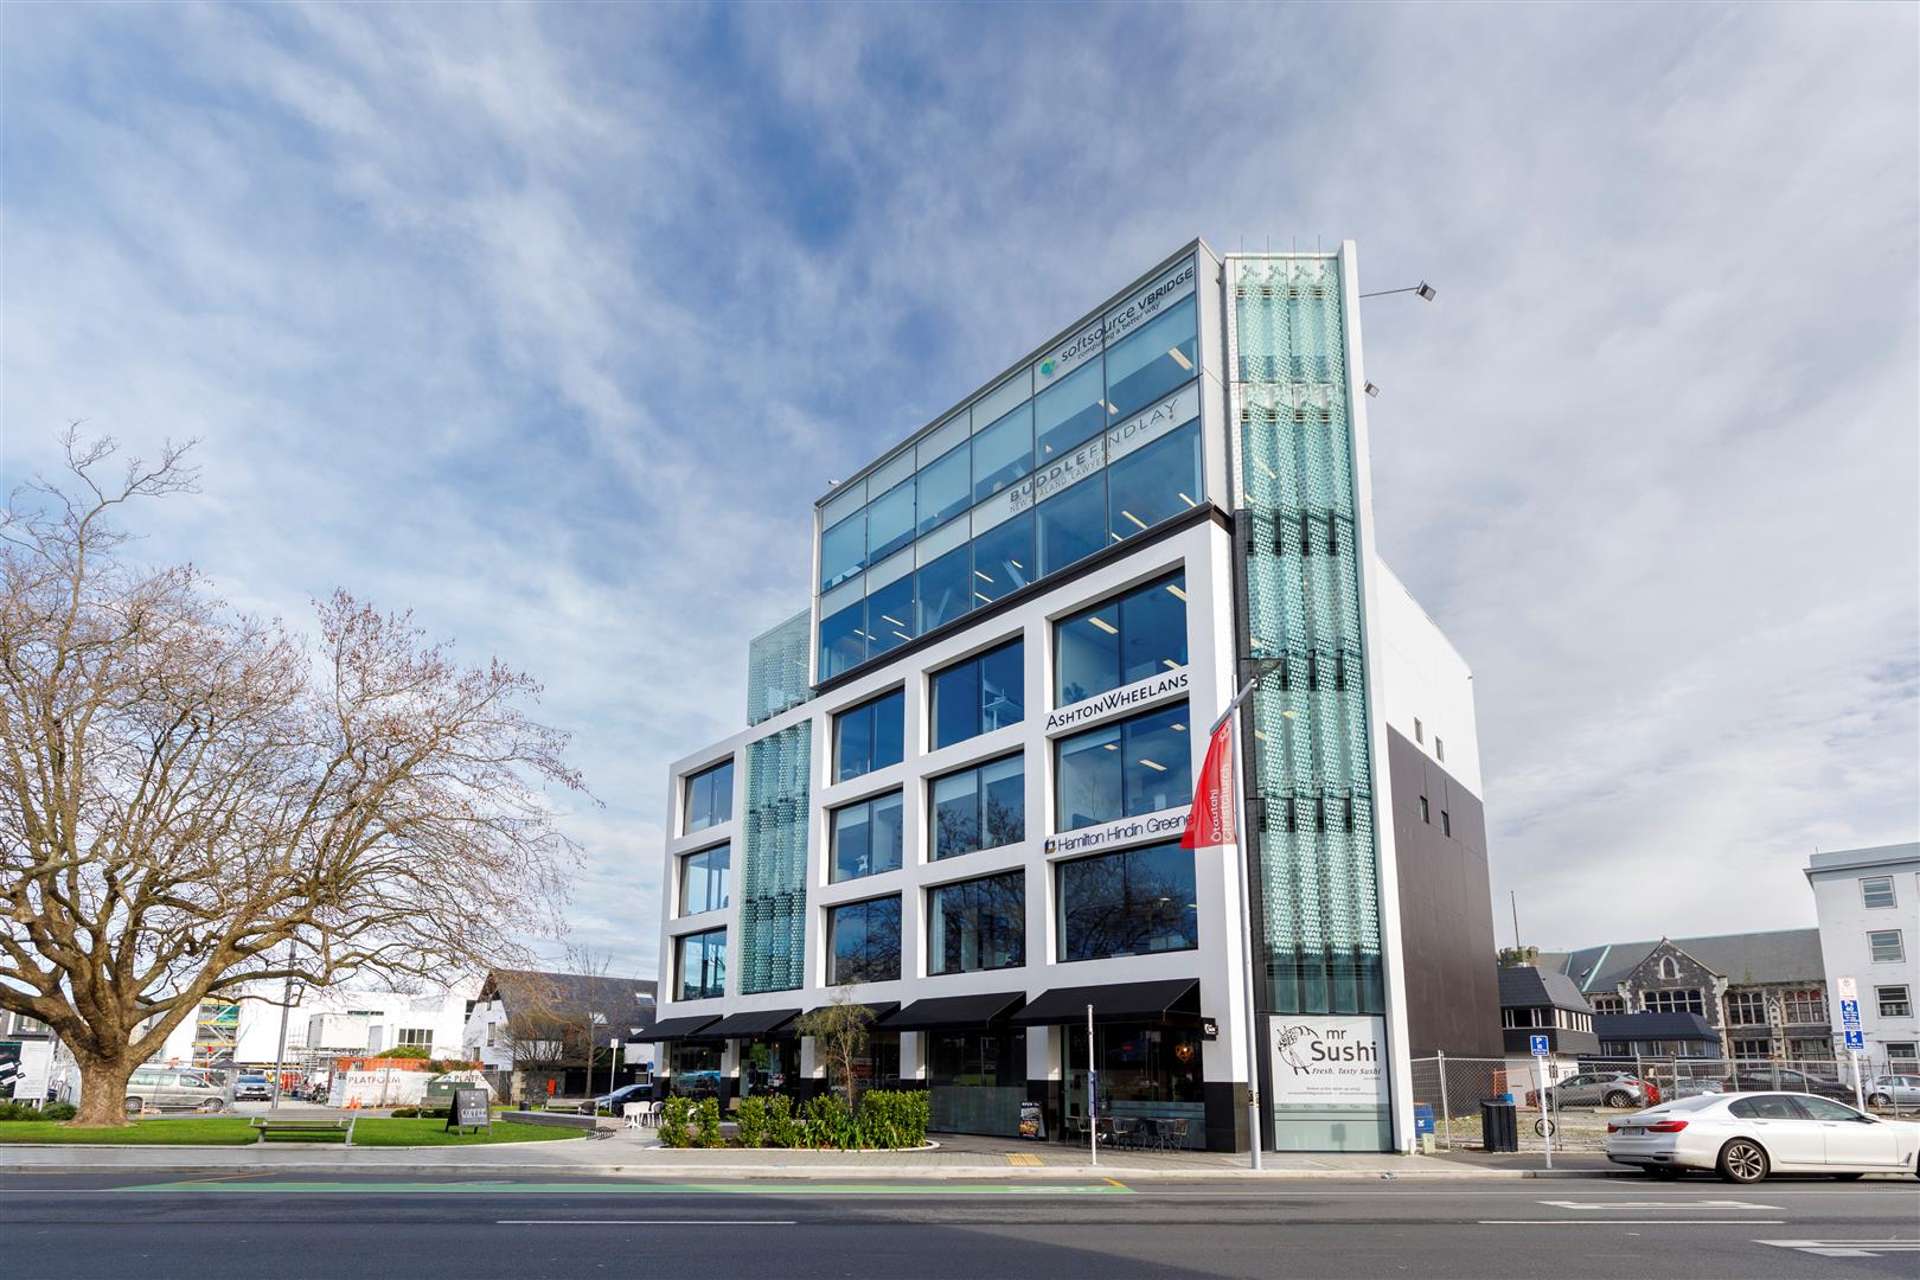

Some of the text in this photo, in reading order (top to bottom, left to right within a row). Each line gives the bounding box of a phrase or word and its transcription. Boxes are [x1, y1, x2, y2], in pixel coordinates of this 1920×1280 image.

[1061, 266, 1193, 361] softsource VBRIDGE
[1058, 832, 1104, 851] Hamilton
[1107, 824, 1143, 841] Hindin
[1326, 1029, 1347, 1039] mr
[1311, 1040, 1377, 1061] Sushi
